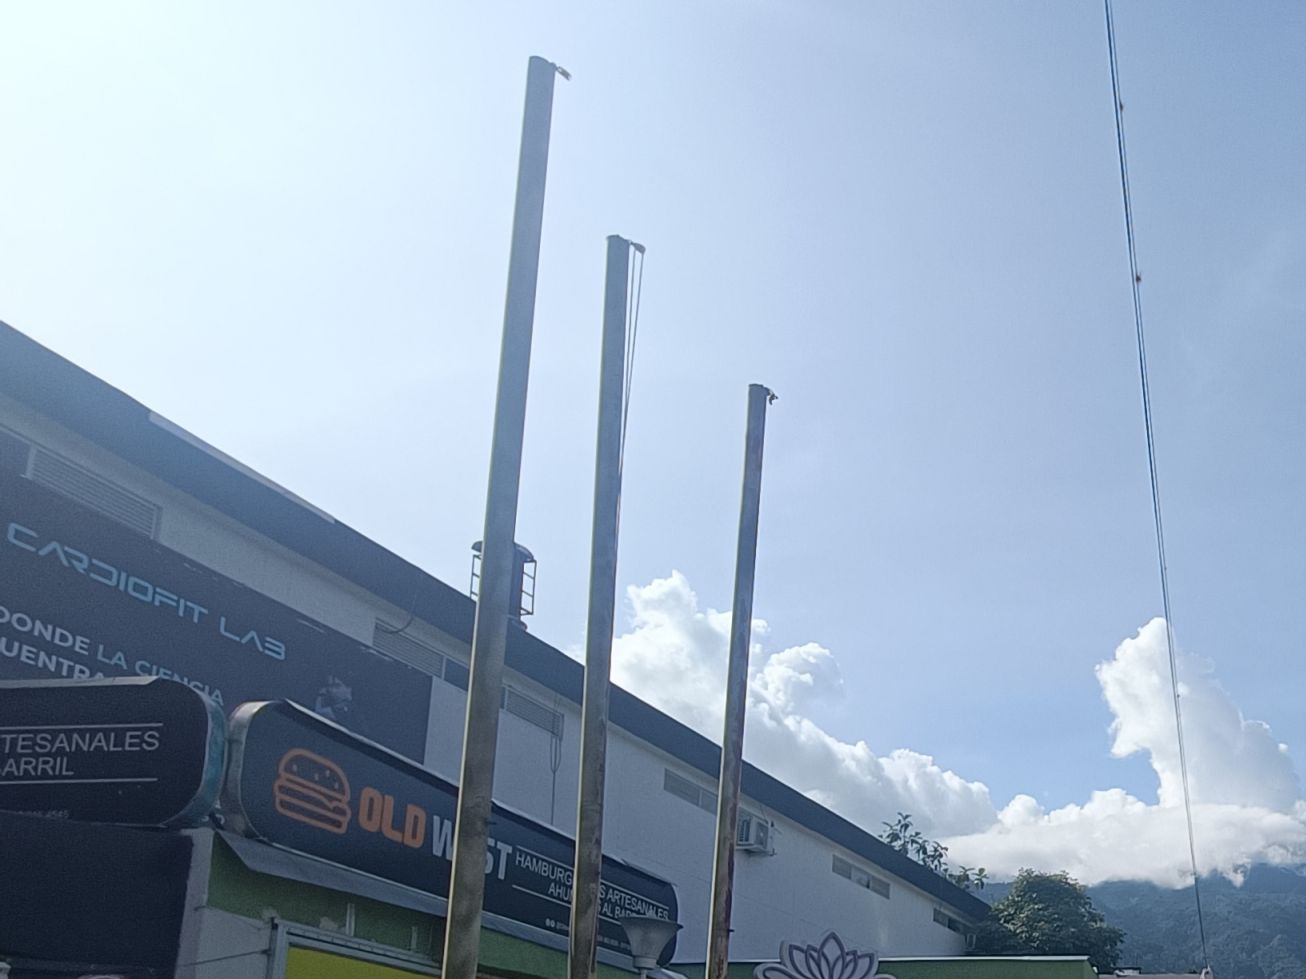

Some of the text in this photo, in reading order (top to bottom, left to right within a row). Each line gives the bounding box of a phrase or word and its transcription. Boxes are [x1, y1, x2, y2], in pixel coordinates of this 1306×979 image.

[7, 522, 286, 661] CARDIOFIT LAB
[97, 644, 128, 670] LA
[0, 731, 160, 753] TESANALES
[358, 787, 512, 880] OLD WST
